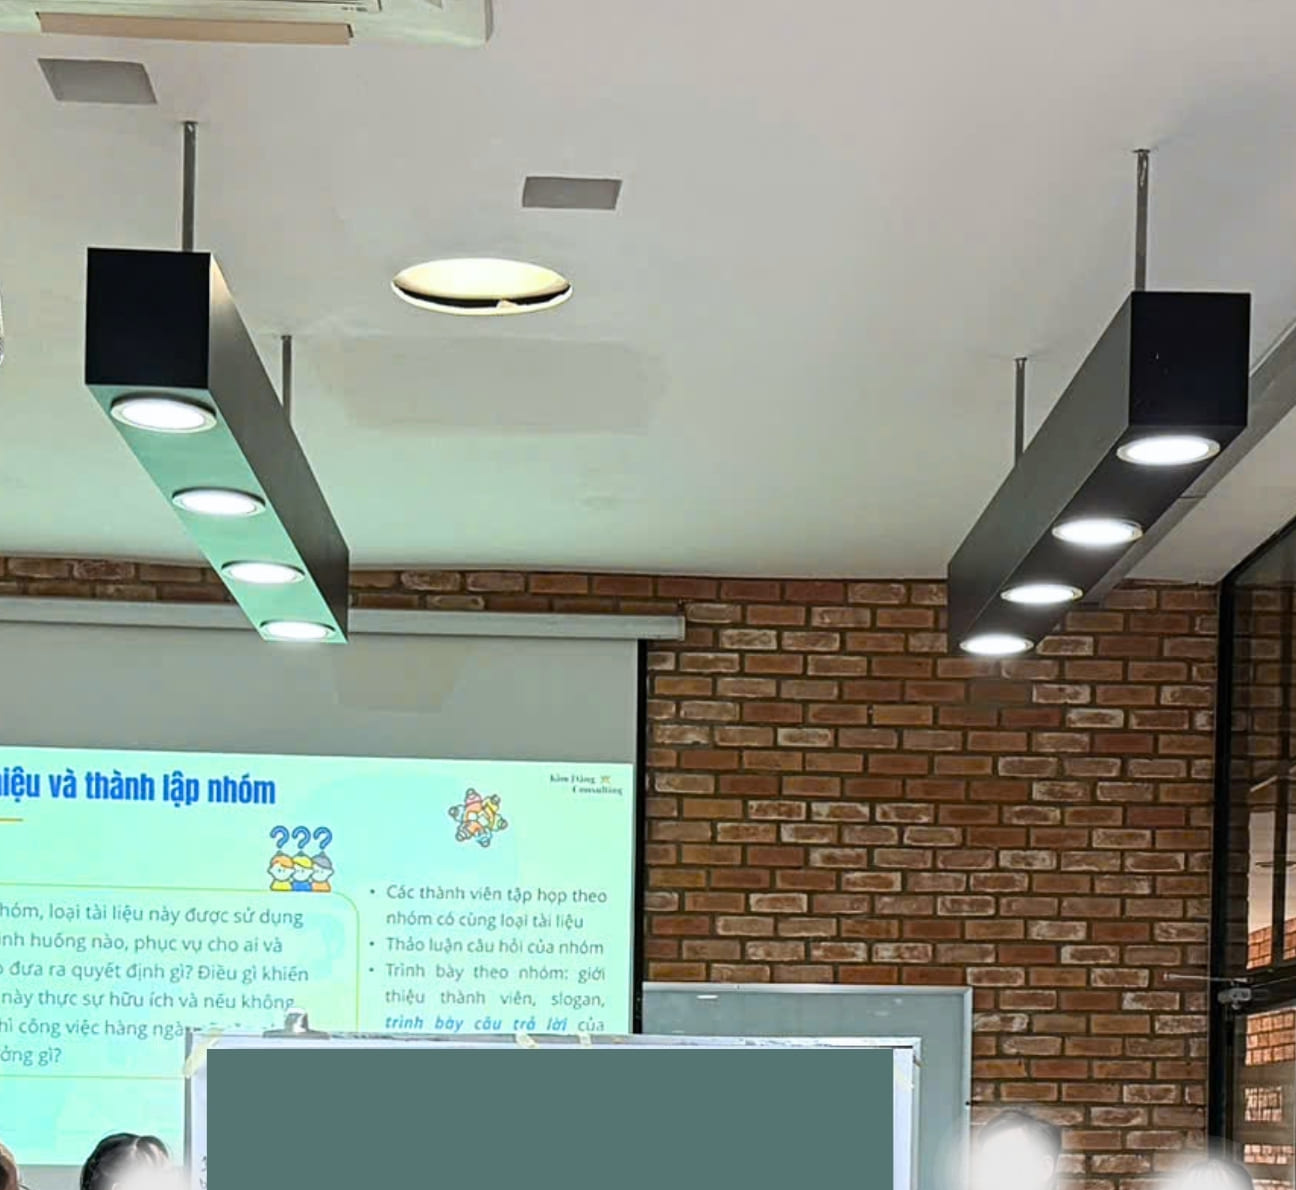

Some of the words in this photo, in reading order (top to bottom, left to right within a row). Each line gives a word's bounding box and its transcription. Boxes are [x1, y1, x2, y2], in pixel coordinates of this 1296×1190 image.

[48, 768, 77, 799] và
[85, 770, 155, 801] thành
[162, 770, 201, 808] lập
[207, 774, 276, 805] nhóm
[386, 884, 415, 899] Các
[419, 885, 465, 900] thành
[470, 886, 502, 901] viên
[507, 886, 532, 904] tập
[572, 888, 608, 903] theo
[49, 903, 80, 922] loại
[86, 904, 107, 920] tài
[113, 905, 143, 924] liệu
[149, 906, 181, 926] này
[185, 907, 229, 925] được
[233, 907, 255, 924] sử
[259, 909, 304, 929] dụng
[386, 910, 432, 926] nhóm
[436, 911, 455, 927] có
[459, 912, 496, 931] cùng
[500, 913, 528, 930] loại
[533, 913, 552, 928] tài
[556, 913, 584, 931] liệu
[30, 932, 86, 952] huống
[134, 935, 178, 954] phục
[182, 939, 202, 954] vụ
[208, 936, 239, 952] cho
[244, 937, 259, 953] ai
[263, 937, 283, 953] và
[385, 936, 425, 952] Thảo
[429, 938, 463, 954] luận
[467, 938, 494, 954] câu
[499, 938, 523, 954] hỏi
[527, 939, 555, 955] của
[559, 939, 604, 955] nhóm
[9, 961, 43, 977] đưa
[49, 964, 66, 977] ra
[71, 962, 121, 981] quyết
[126, 962, 165, 982] định
[169, 964, 194, 984] gì?
[198, 964, 238, 981] Điều
[242, 965, 257, 985] gì
[262, 966, 309, 982] khiến
[385, 961, 425, 978] Trình
[436, 964, 464, 982] bày
[473, 964, 509, 979] theo
[518, 965, 569, 980] nhóm:
[577, 966, 606, 984] giới
[2, 988, 33, 1008] này
[38, 989, 78, 1008] thực
[82, 992, 105, 1008] sự
[110, 991, 144, 1008] hữu
[149, 992, 174, 1008] ích
[178, 992, 199, 1009] và
[204, 993, 236, 1009] nếu
[385, 989, 425, 1006] thiệu
[440, 990, 486, 1005] thành
[500, 990, 537, 1007] viên,
[551, 989, 606, 1010] slogan,
[19, 1018, 61, 1039] công
[66, 1019, 100, 1037] việc
[105, 1020, 148, 1040] hàng
[153, 1021, 186, 1040] ngà
[385, 1016, 424, 1030] trình
[434, 1016, 464, 1033] bày
[474, 1016, 502, 1031] câu
[513, 1016, 537, 1031] trả
[546, 1016, 568, 1032] lời
[577, 1016, 605, 1033] của
[38, 1047, 62, 1067] gì?
